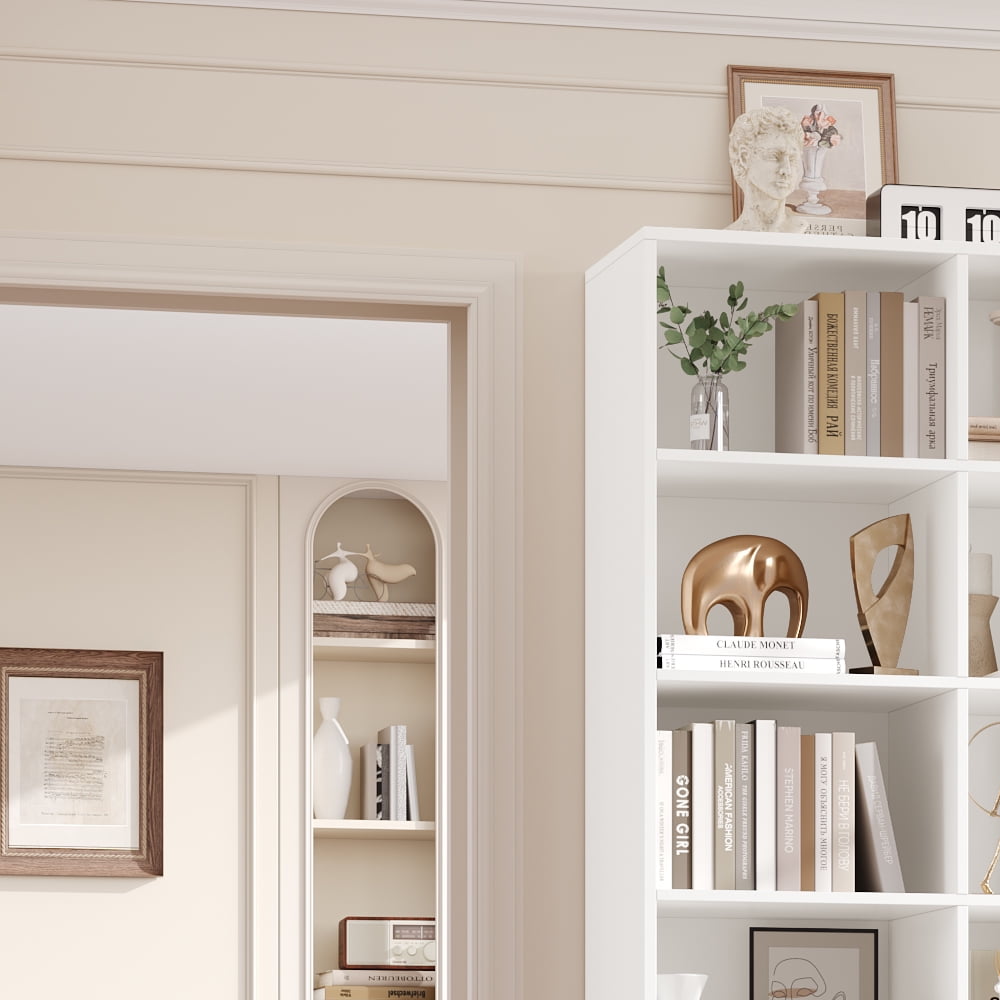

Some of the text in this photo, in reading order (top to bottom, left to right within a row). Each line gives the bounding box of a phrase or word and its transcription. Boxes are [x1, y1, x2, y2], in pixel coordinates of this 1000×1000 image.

[902, 210, 937, 240] 10
[826, 314, 838, 409] БОЖЕСТВЕННАЯ КОМЕДИЯ
[826, 415, 842, 437] РАЙ
[925, 362, 939, 450] Триумфальная арка
[716, 640, 795, 650] CLAUDE MONET
[719, 659, 805, 670] HENRI ROUSSEAU
[676, 775, 689, 856] GONE GIRL
[725, 763, 733, 851] AMERICAN FASHION
[784, 768, 793, 853] STEPHEN MARINO
